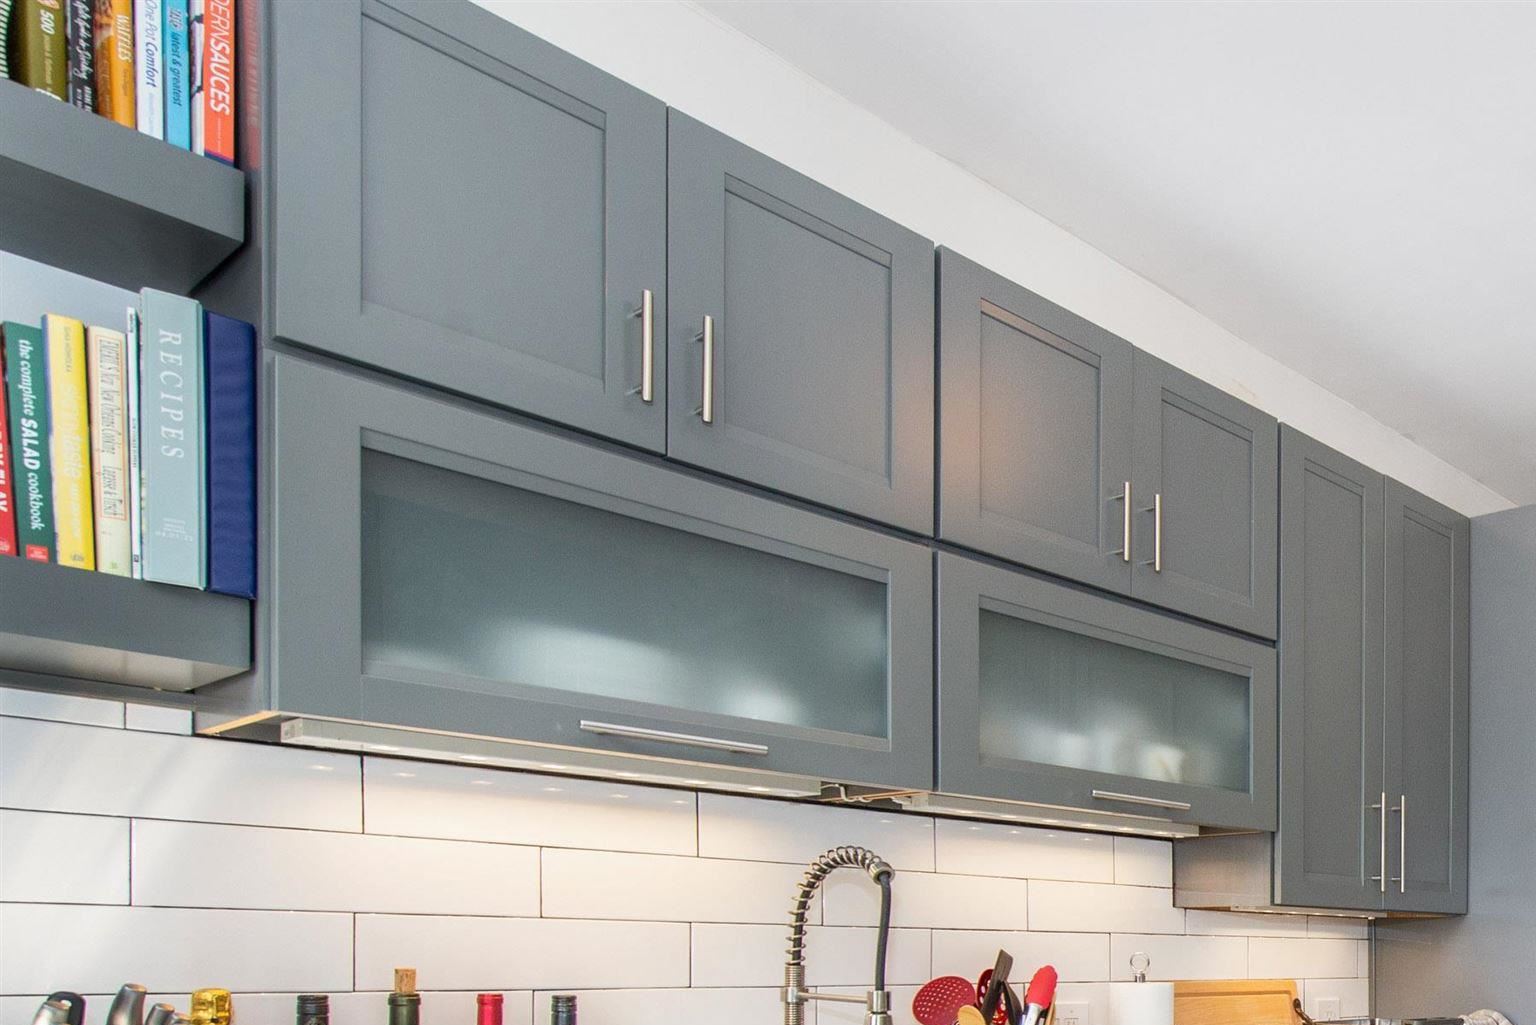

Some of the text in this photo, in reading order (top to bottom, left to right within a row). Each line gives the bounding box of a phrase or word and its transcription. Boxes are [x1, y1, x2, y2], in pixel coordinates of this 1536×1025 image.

[40, 9, 55, 35] 500
[116, 14, 132, 62] WAFFLES
[171, 31, 182, 57] latest
[145, 42, 159, 88] Comfort
[170, 66, 183, 107] greatest
[18, 339, 33, 358] the
[17, 360, 37, 416] complete
[160, 328, 184, 459] RECIPES
[20, 418, 41, 470] SALAD
[27, 472, 45, 531] cookbook
